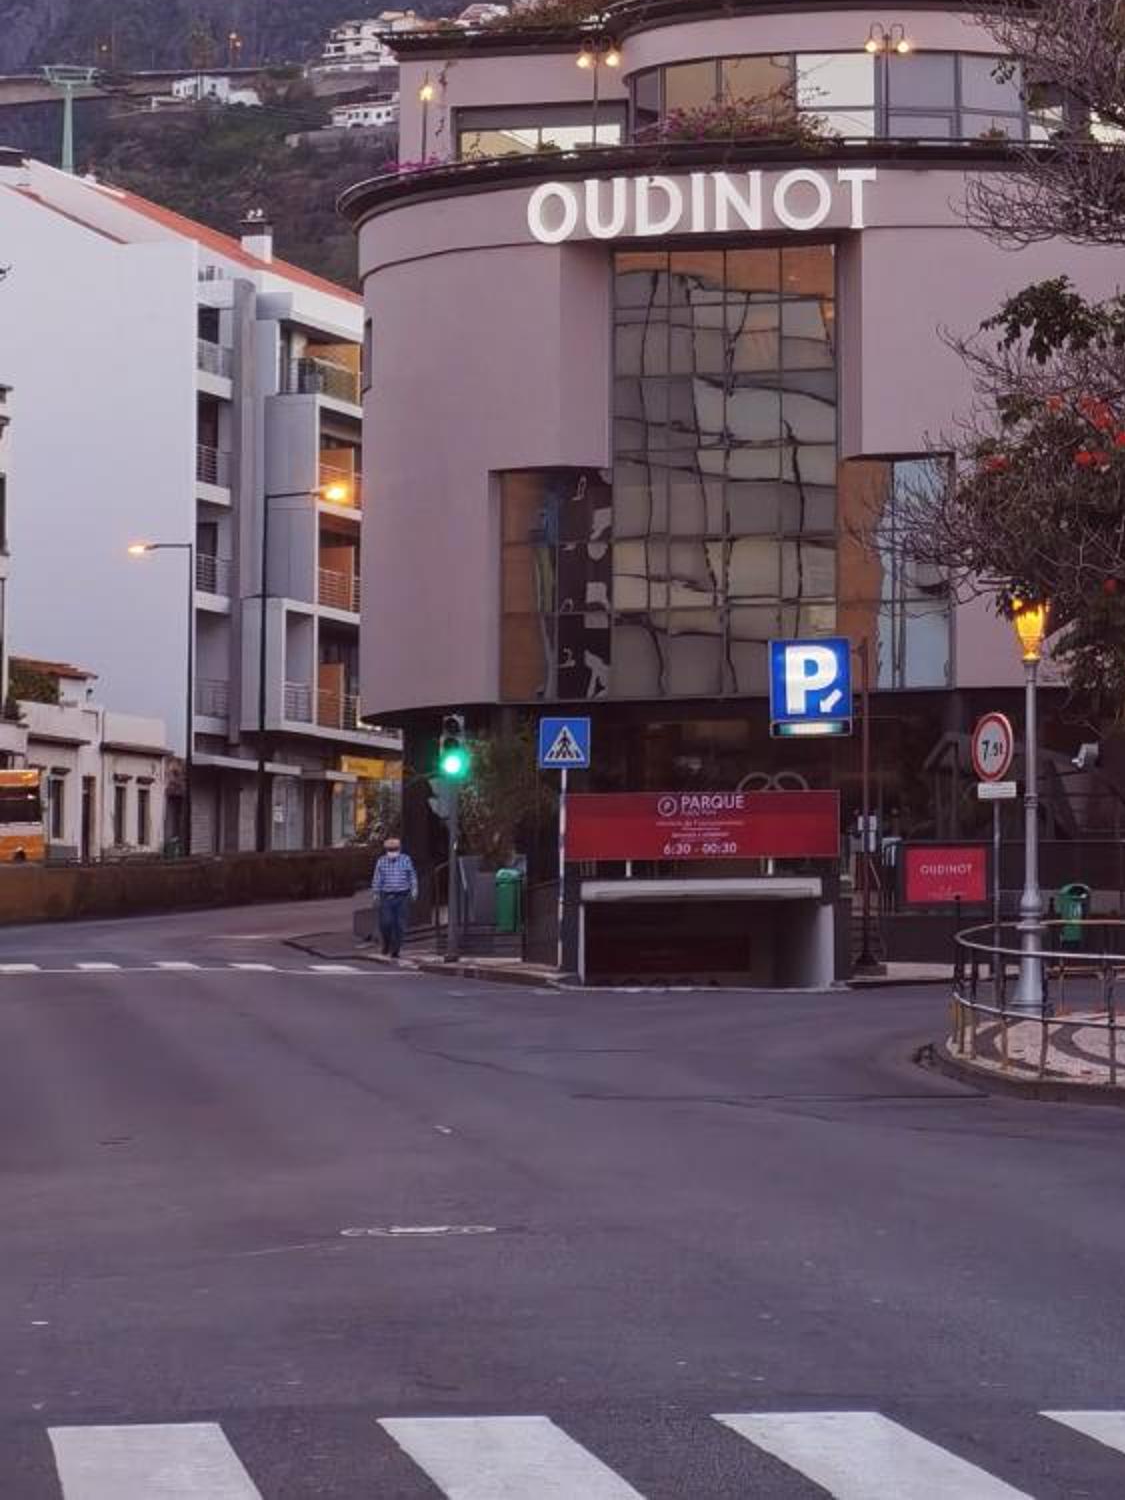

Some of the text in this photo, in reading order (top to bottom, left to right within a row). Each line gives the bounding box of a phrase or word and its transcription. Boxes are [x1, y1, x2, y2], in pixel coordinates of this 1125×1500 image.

[527, 167, 877, 244] OUDINOT
[785, 645, 837, 714] P
[681, 794, 745, 810] PARQUE
[920, 863, 972, 877] OUDINOT
